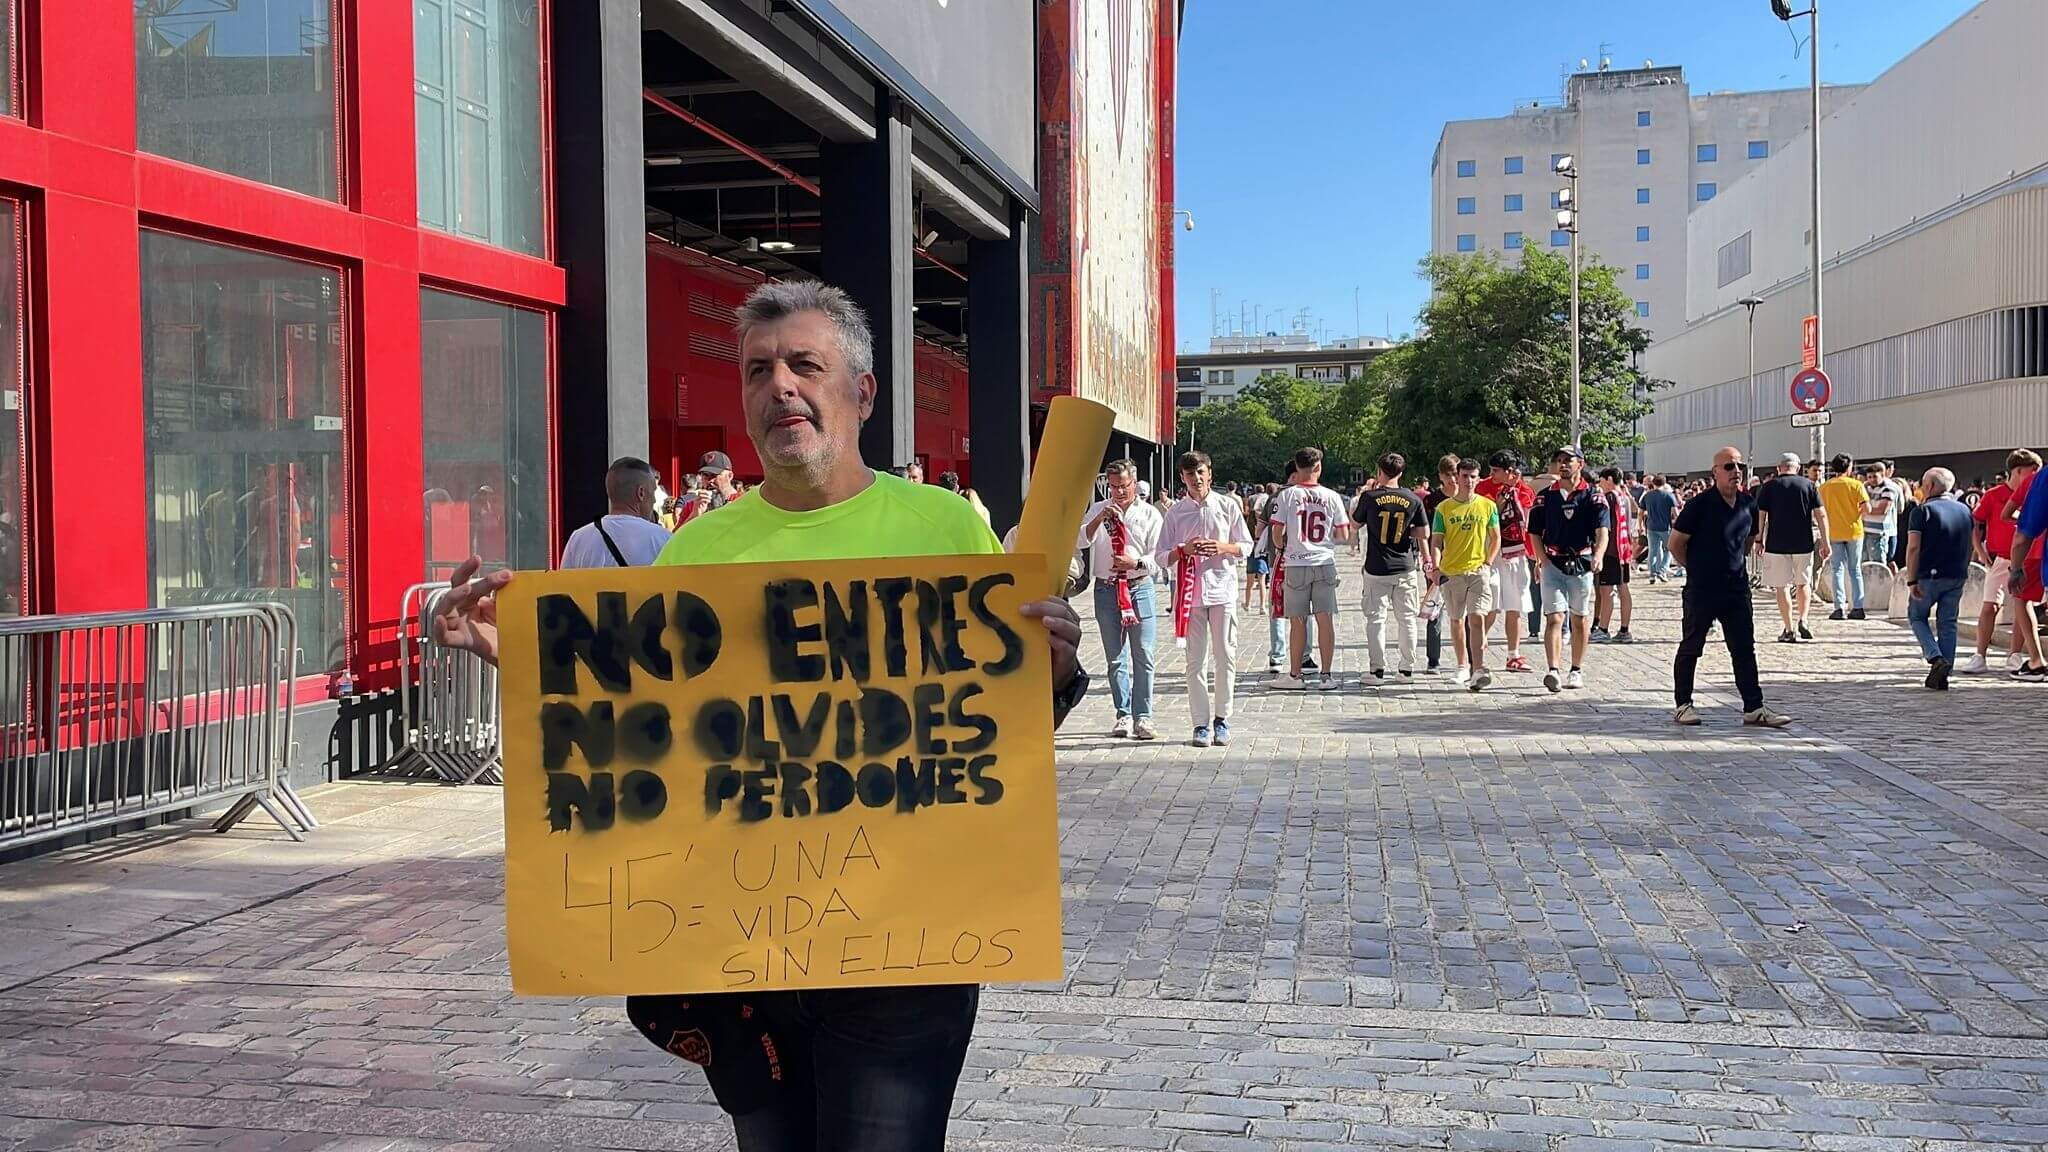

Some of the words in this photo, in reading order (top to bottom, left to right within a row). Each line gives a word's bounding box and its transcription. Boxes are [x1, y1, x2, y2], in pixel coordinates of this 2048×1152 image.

[1297, 510, 1326, 543] 16
[1379, 511, 1405, 545] 11
[536, 590, 722, 694] NO
[766, 573, 1023, 682] ENTRES
[541, 699, 673, 770] NO
[696, 683, 998, 761] OLVIDES
[546, 770, 668, 832] NO
[733, 825, 881, 892] UNA
[732, 887, 861, 941] VIDA
[720, 939, 812, 987] SIN
[839, 927, 1020, 975] ELLOS
